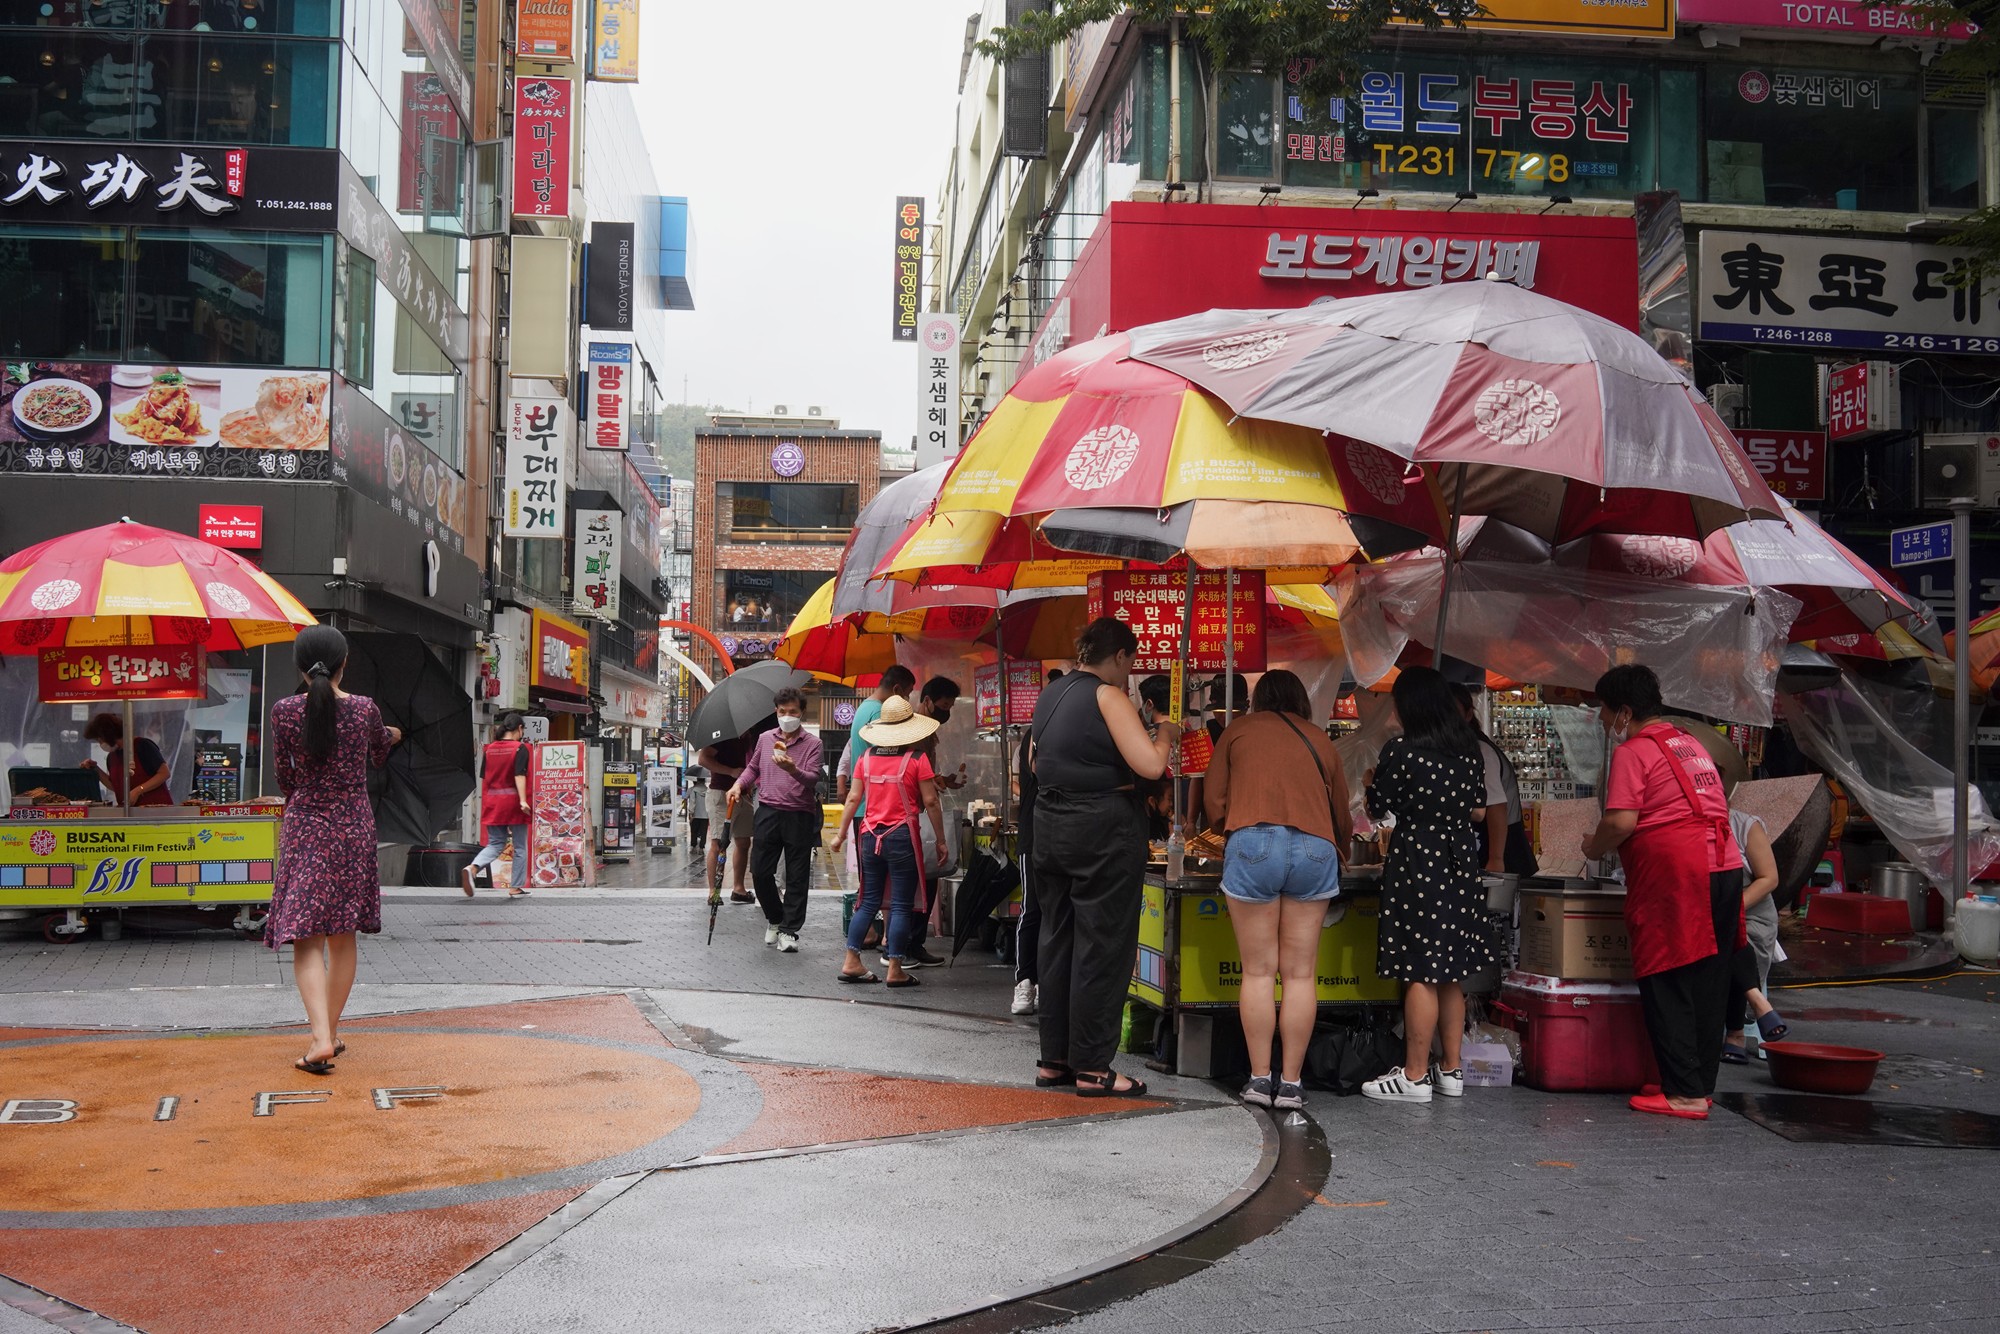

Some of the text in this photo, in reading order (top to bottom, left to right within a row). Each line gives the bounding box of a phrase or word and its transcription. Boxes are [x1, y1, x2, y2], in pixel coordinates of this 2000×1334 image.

[1782, 3, 1853, 26] TOTAL
[1868, 8, 1950, 33] BEAUTY
[1773, 73, 1880, 110] 꽃샘헤어
[1361, 71, 1634, 143] 월드 부동산
[531, 121, 557, 203] 마라탕
[1373, 143, 1455, 176] T.231
[228, 154, 244, 194] 마라탕
[256, 200, 333, 211] T.051.242.1888
[534, 204, 552, 214] 2F
[898, 203, 921, 327] 동아 성인 게임랜드
[1258, 231, 1541, 291] 보드게임카페
[901, 328, 913, 337] 5F
[932, 331, 947, 340] 꽃샘
[1753, 328, 1833, 342] T.246-1268
[595, 365, 624, 447] 방탈출
[928, 357, 950, 449] 꽃샘헤어
[1831, 384, 1867, 432] 부동산
[512, 403, 522, 441] 동두천
[26, 448, 84, 468] 볶음면
[130, 451, 202, 471] 꿔바로우
[1744, 437, 1814, 474] 동산
[258, 454, 298, 475] 전병
[523, 404, 558, 529] 부대찌개
[1209, 459, 1257, 468] BUSAN
[1180, 466, 1321, 479] International Film Festival
[1205, 473, 1256, 483] October,
[1258, 475, 1286, 484] 2020
[1796, 480, 1810, 491] 3F
[205, 529, 256, 538] 공식 인증 대리점
[584, 534, 613, 547] 고집
[1902, 528, 1948, 549] 남포길 50
[1901, 547, 1933, 561] Nampo-gil
[1129, 573, 1147, 585] 원조
[1150, 574, 1168, 585] 元祖
[1203, 573, 1221, 585] 전통
[1198, 640, 1245, 653] 釜山饼
[57, 653, 171, 687] 대왕 닭꼬치
[1132, 658, 1199, 670] 포장됩다
[545, 769, 562, 778] Little
[563, 769, 583, 778] India
[1693, 771, 1718, 788] ATER
[1530, 782, 1541, 791] 20
[1566, 782, 1573, 791] 8
[229, 806, 250, 816] 닭꼬치
[260, 806, 282, 816] 소세지
[66, 832, 126, 843] BUSAN
[66, 843, 196, 853] International Film Festival
[1317, 975, 1360, 986] Festival
